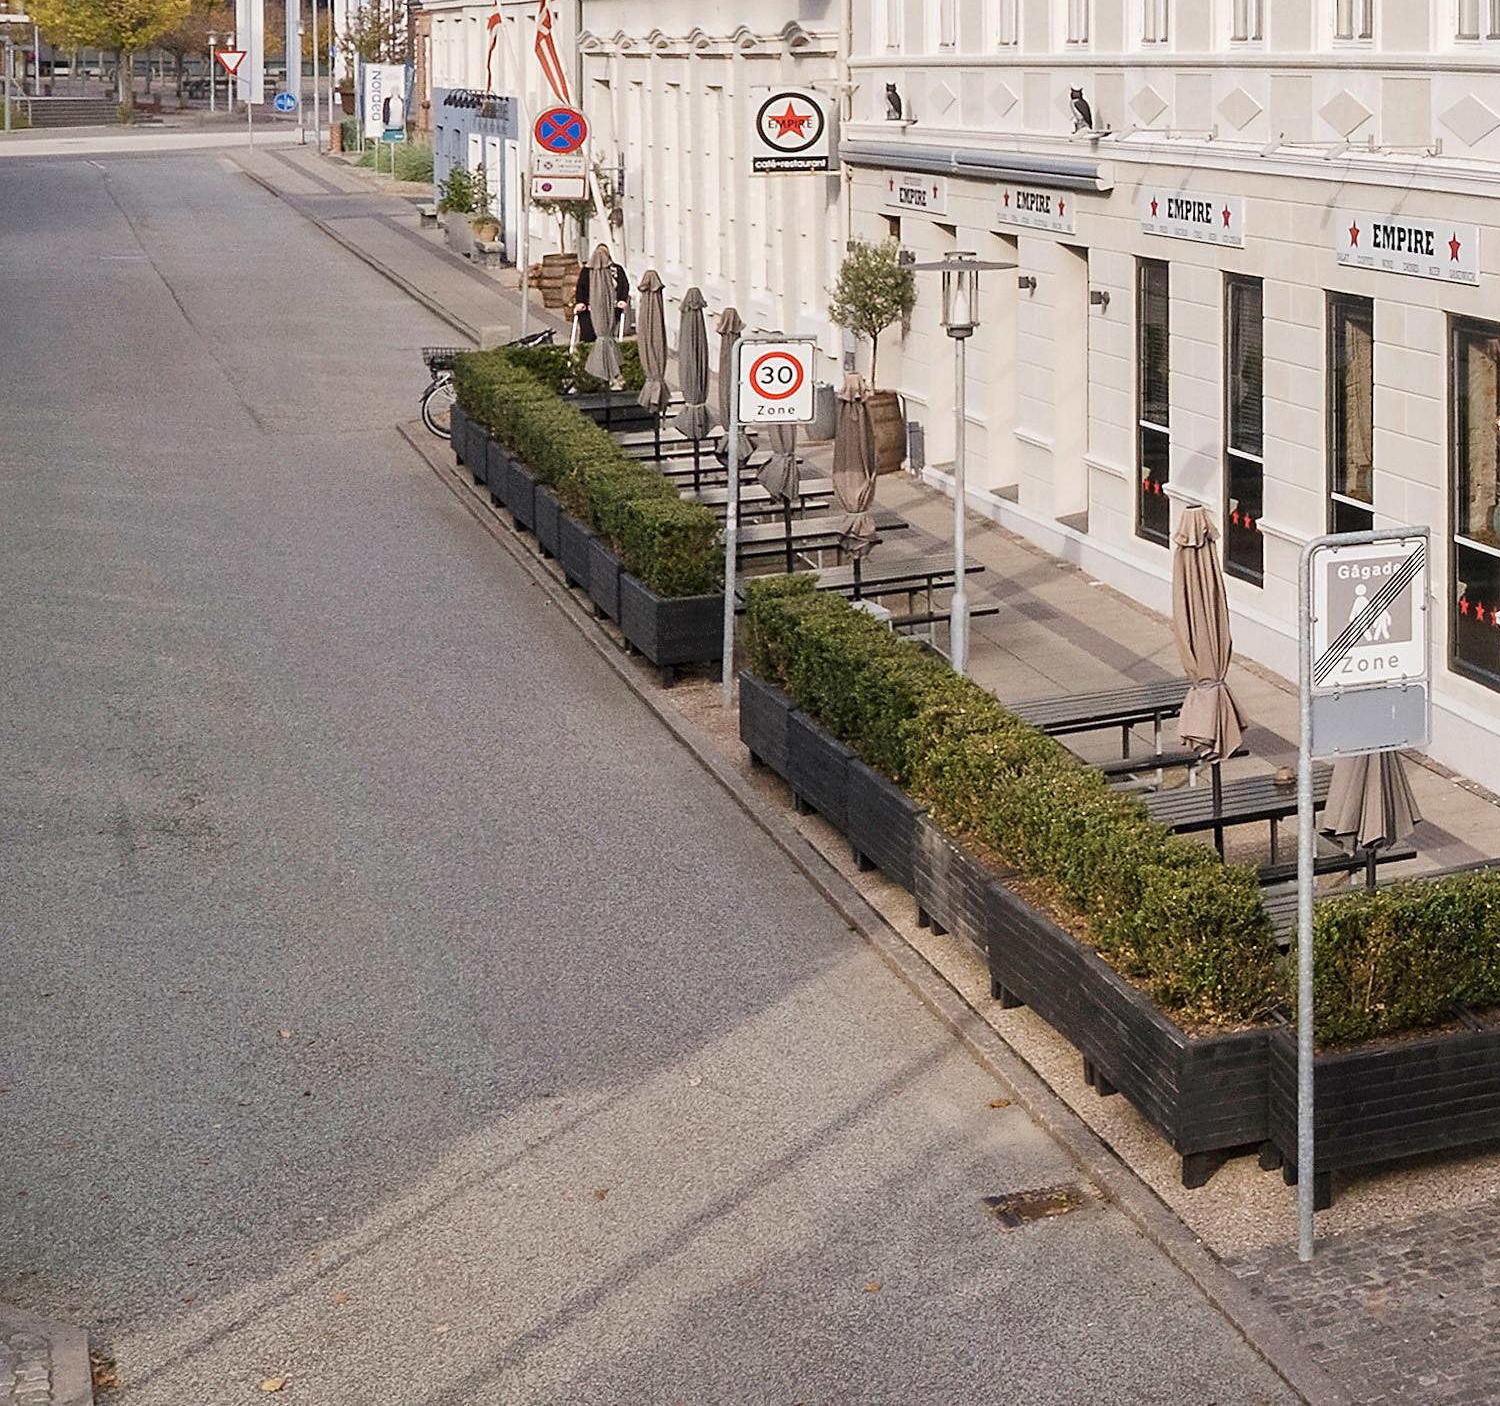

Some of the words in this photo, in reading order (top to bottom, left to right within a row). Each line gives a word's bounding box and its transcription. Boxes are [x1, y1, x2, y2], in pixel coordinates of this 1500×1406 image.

[371, 70, 381, 122] Nordea
[768, 118, 813, 129] EMPIRE
[900, 187, 927, 207] EMPIRE
[1016, 191, 1051, 214] EMPIRE
[1167, 198, 1212, 224] EMPIRE
[1372, 223, 1435, 256] EMPIRE
[761, 366, 793, 385] 30
[757, 405, 796, 415] Zone
[1337, 561, 1402, 579] Gågade
[1341, 655, 1400, 674] Zone
